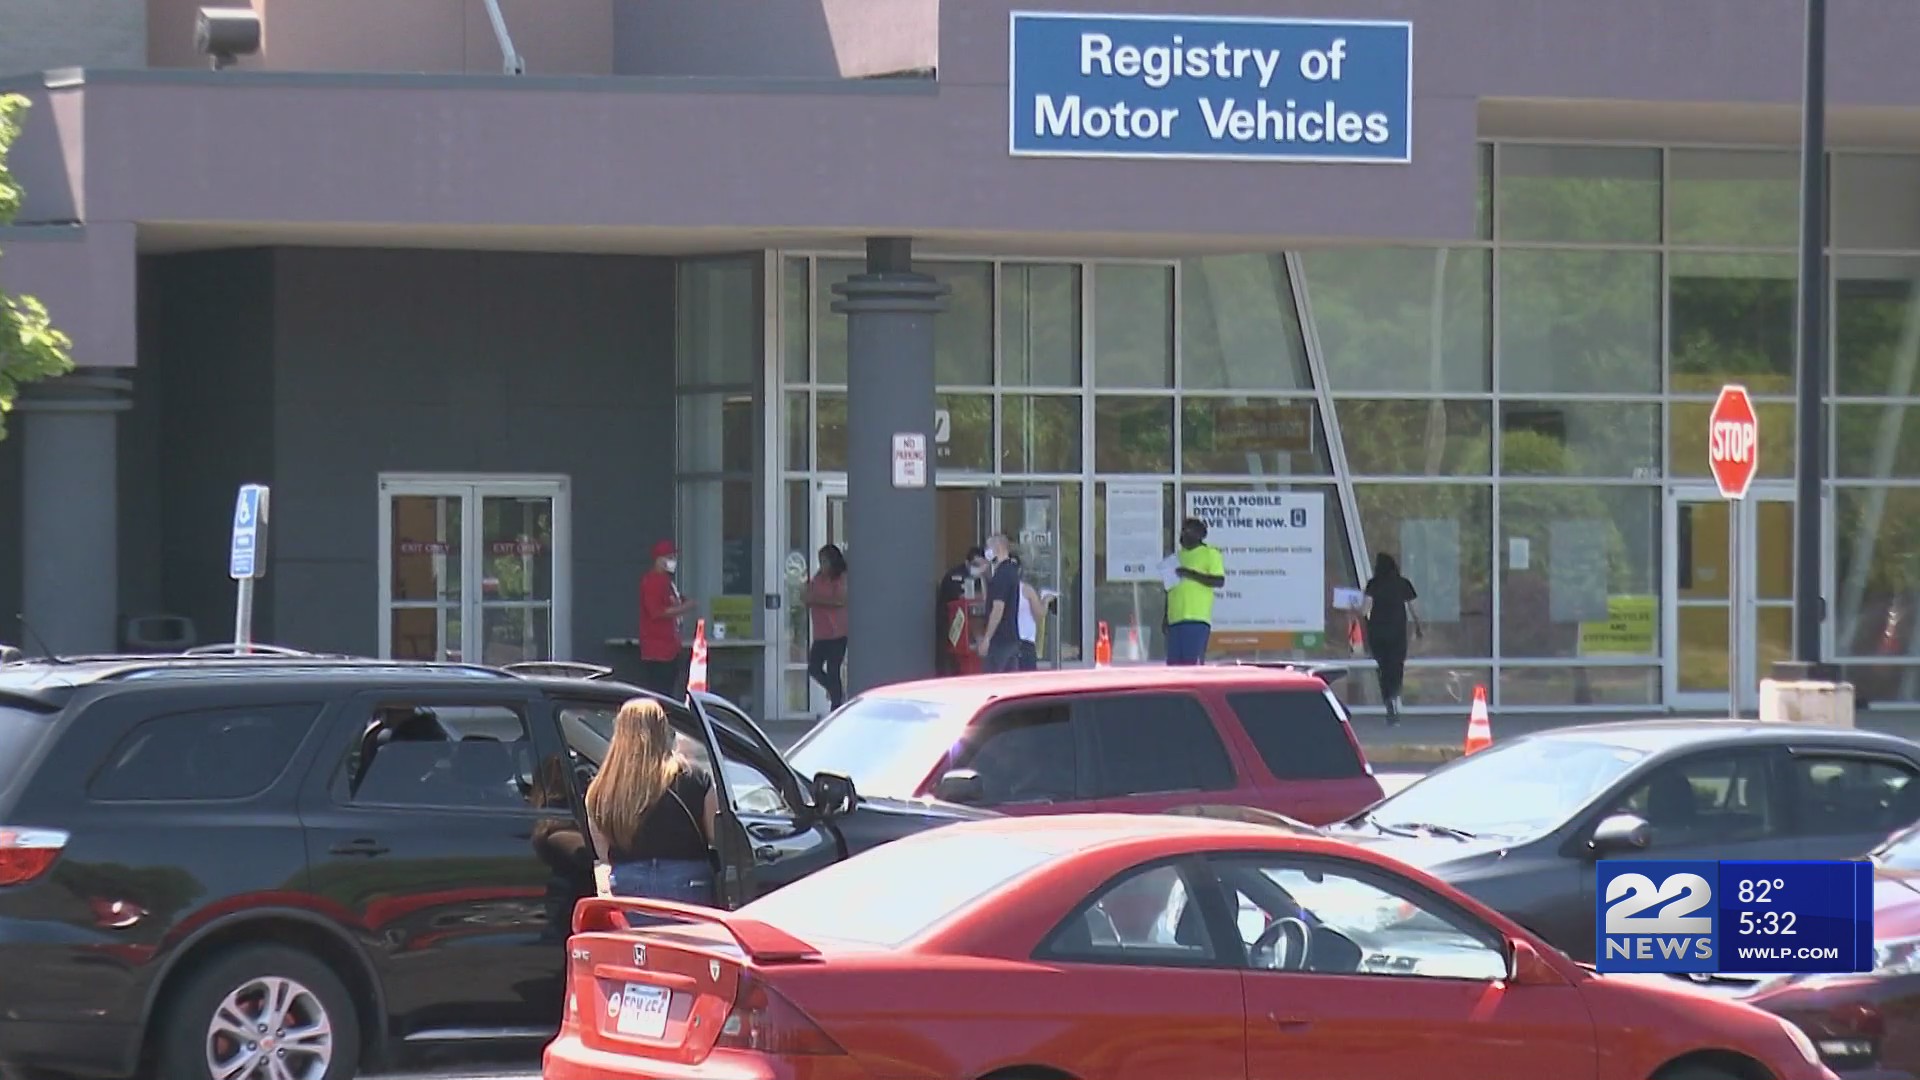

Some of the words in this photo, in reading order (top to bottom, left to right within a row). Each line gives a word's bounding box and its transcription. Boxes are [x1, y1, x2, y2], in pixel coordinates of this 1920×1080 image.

[1080, 33, 1280, 88] Registry
[1300, 38, 1346, 81] of
[1035, 94, 1179, 138] Motor
[1199, 97, 1390, 144] Vehicles
[903, 438, 916, 449] NO
[1713, 422, 1754, 463] STOP
[895, 450, 924, 460] PARKING
[1193, 496, 1225, 506] HAVE
[1227, 496, 1237, 506] A
[1239, 496, 1282, 507] MOBILE
[1193, 507, 1241, 518] DEVICE?
[1203, 518, 1225, 529] AVE
[1228, 518, 1254, 529] TIME
[1256, 518, 1288, 529] NOW.
[401, 543, 421, 553] EXIT
[424, 543, 450, 553] ONLY
[493, 543, 515, 553] EXIT
[517, 543, 542, 553] ONLY
